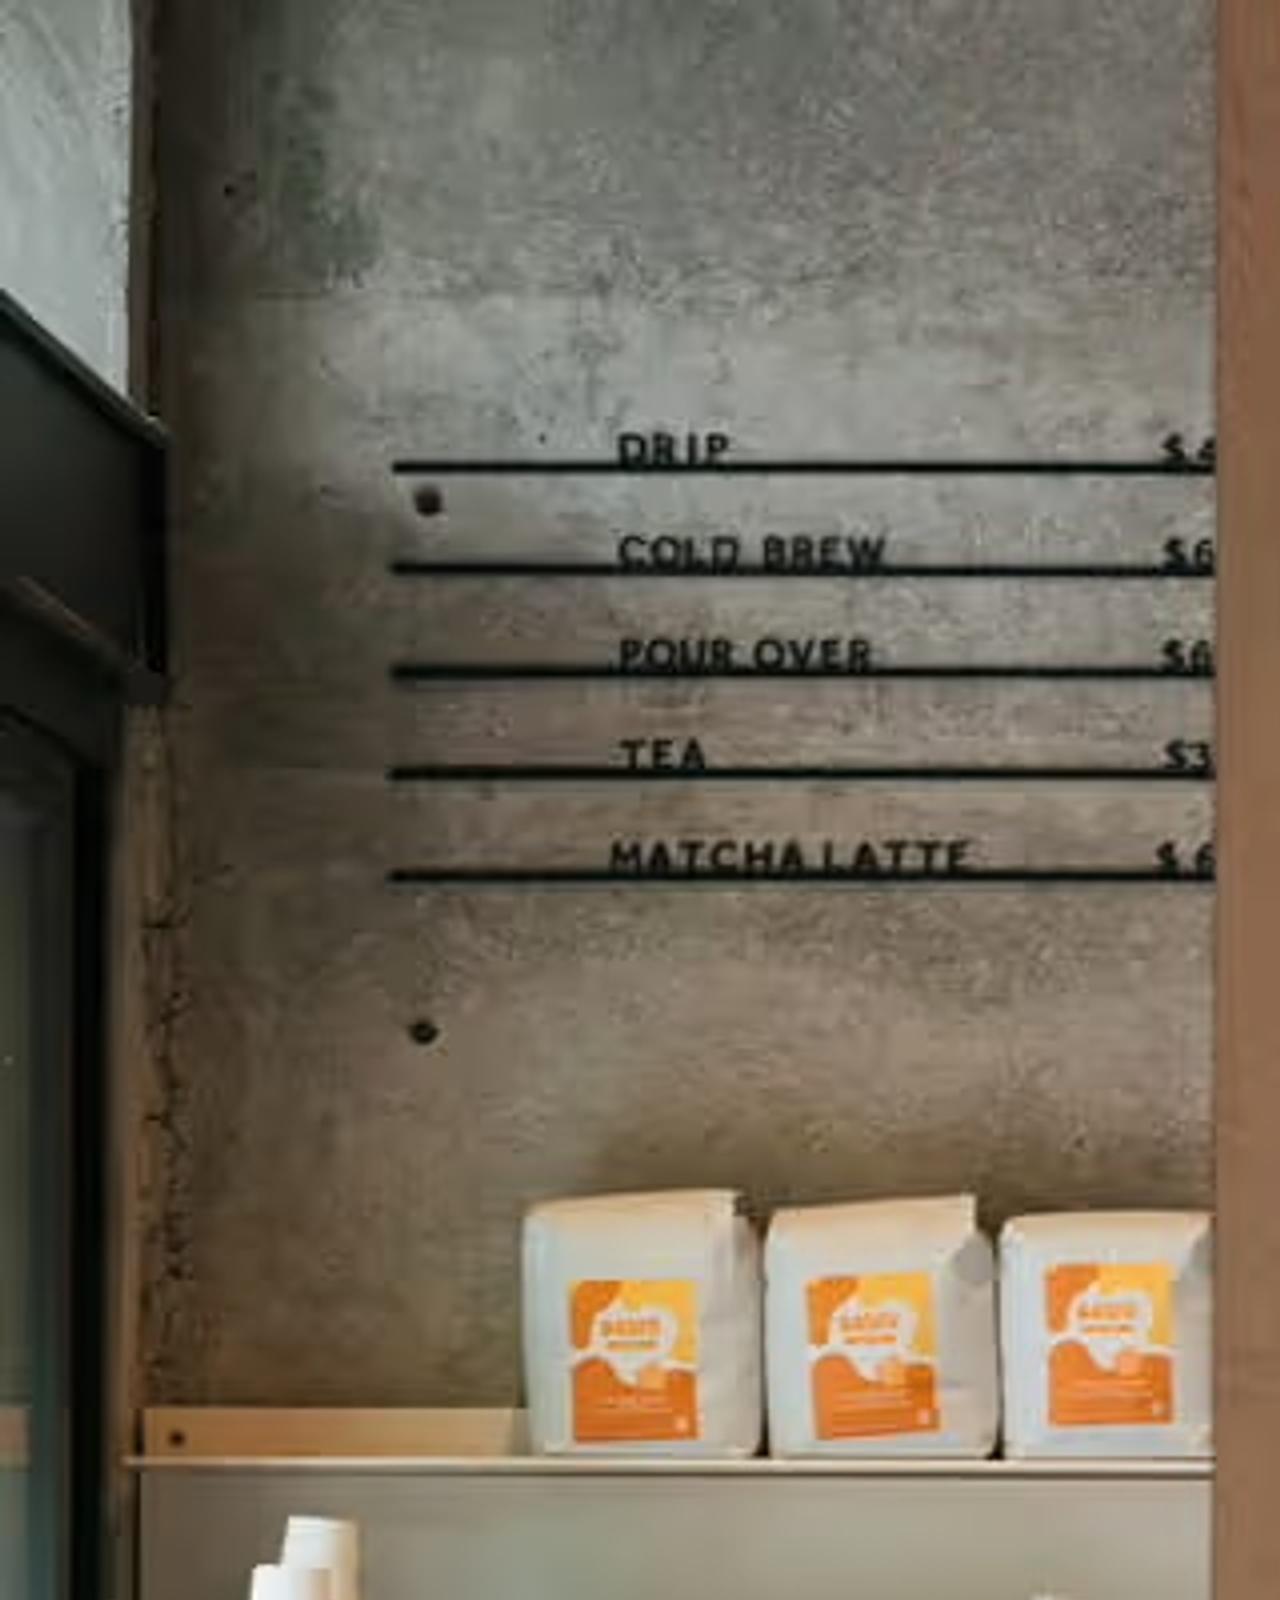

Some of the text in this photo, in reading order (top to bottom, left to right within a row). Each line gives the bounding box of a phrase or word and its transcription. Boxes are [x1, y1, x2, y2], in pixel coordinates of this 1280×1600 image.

[616, 431, 730, 468] DRIP
[617, 534, 1214, 571] COLD BREW $6
[618, 638, 734, 673] POUR
[753, 638, 872, 673] OVER
[619, 737, 1212, 771] TEA $3
[610, 838, 804, 874] MATCHA
[822, 838, 973, 873] LATTE
